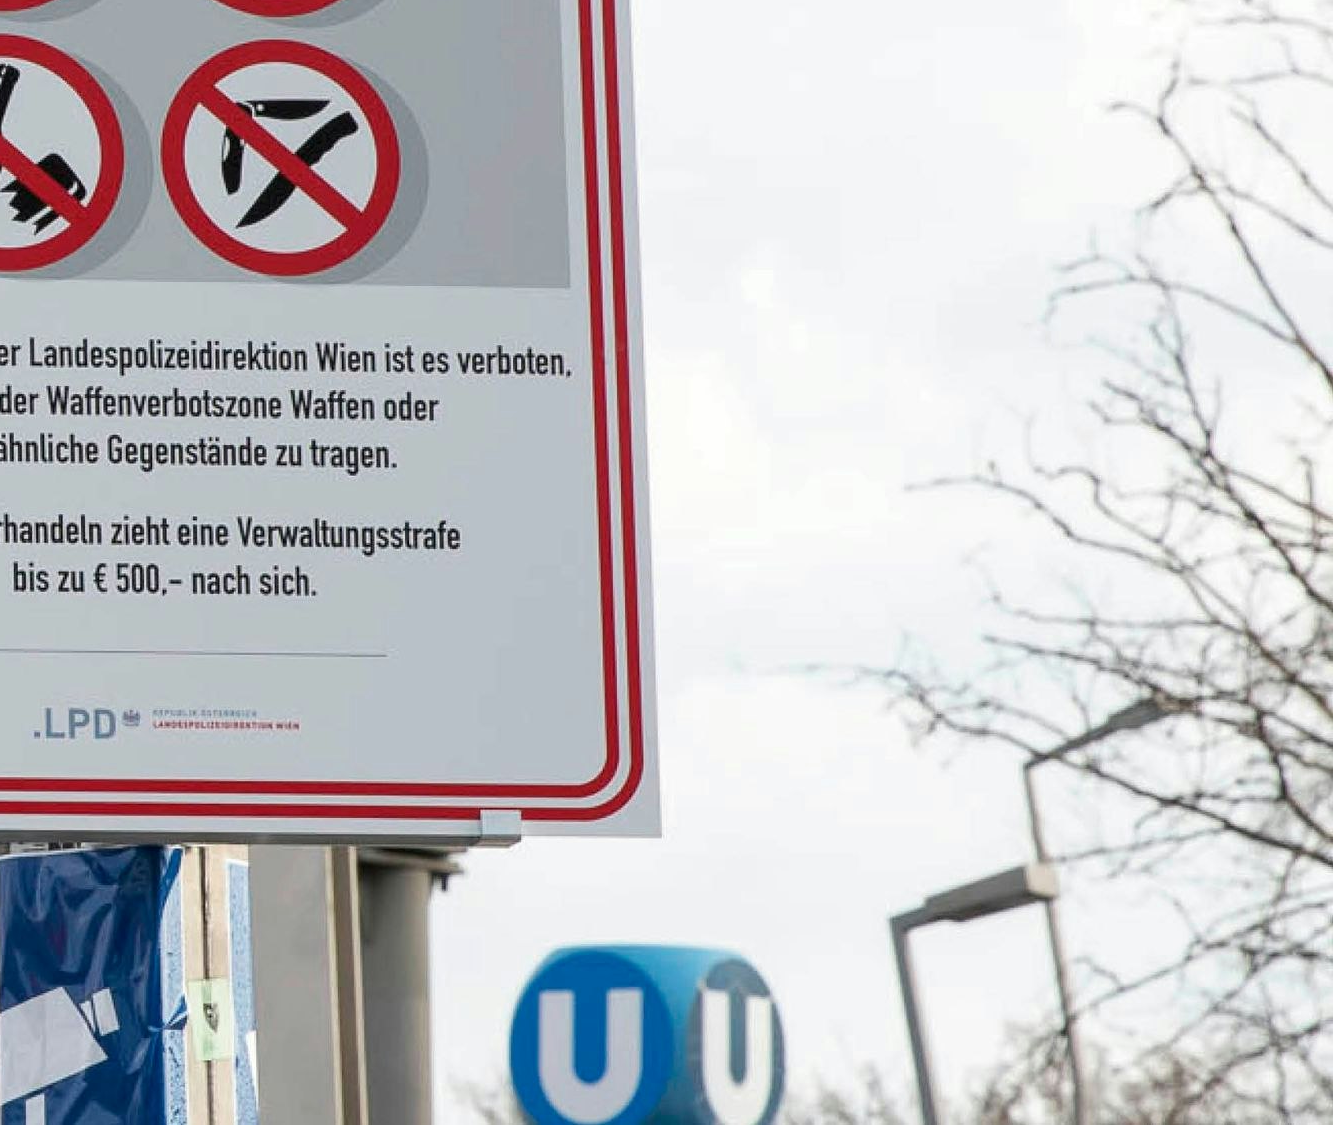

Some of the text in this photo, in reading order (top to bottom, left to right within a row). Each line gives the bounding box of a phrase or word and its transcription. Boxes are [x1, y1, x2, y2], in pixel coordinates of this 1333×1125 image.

[29, 336, 308, 377] Landespolizeidirektion
[315, 341, 377, 373] Wien
[384, 342, 416, 373] ist
[422, 351, 451, 375] es
[45, 385, 282, 420] Waffenverbotszone
[289, 389, 376, 421] Waffen
[383, 391, 440, 422] oder
[107, 434, 268, 473] Gegenstände
[275, 444, 303, 467] zu
[308, 438, 398, 477] tragen.
[110, 515, 171, 546] zieht
[177, 515, 229, 547] eine
[236, 516, 461, 558] Verwaltungsstrafe
[13, 561, 50, 593] bis
[57, 570, 86, 593] zu
[92, 562, 108, 593] €
[192, 564, 251, 595] nach
[259, 564, 317, 597] sich.
[538, 987, 645, 1125] U
[702, 989, 773, 1125] U
